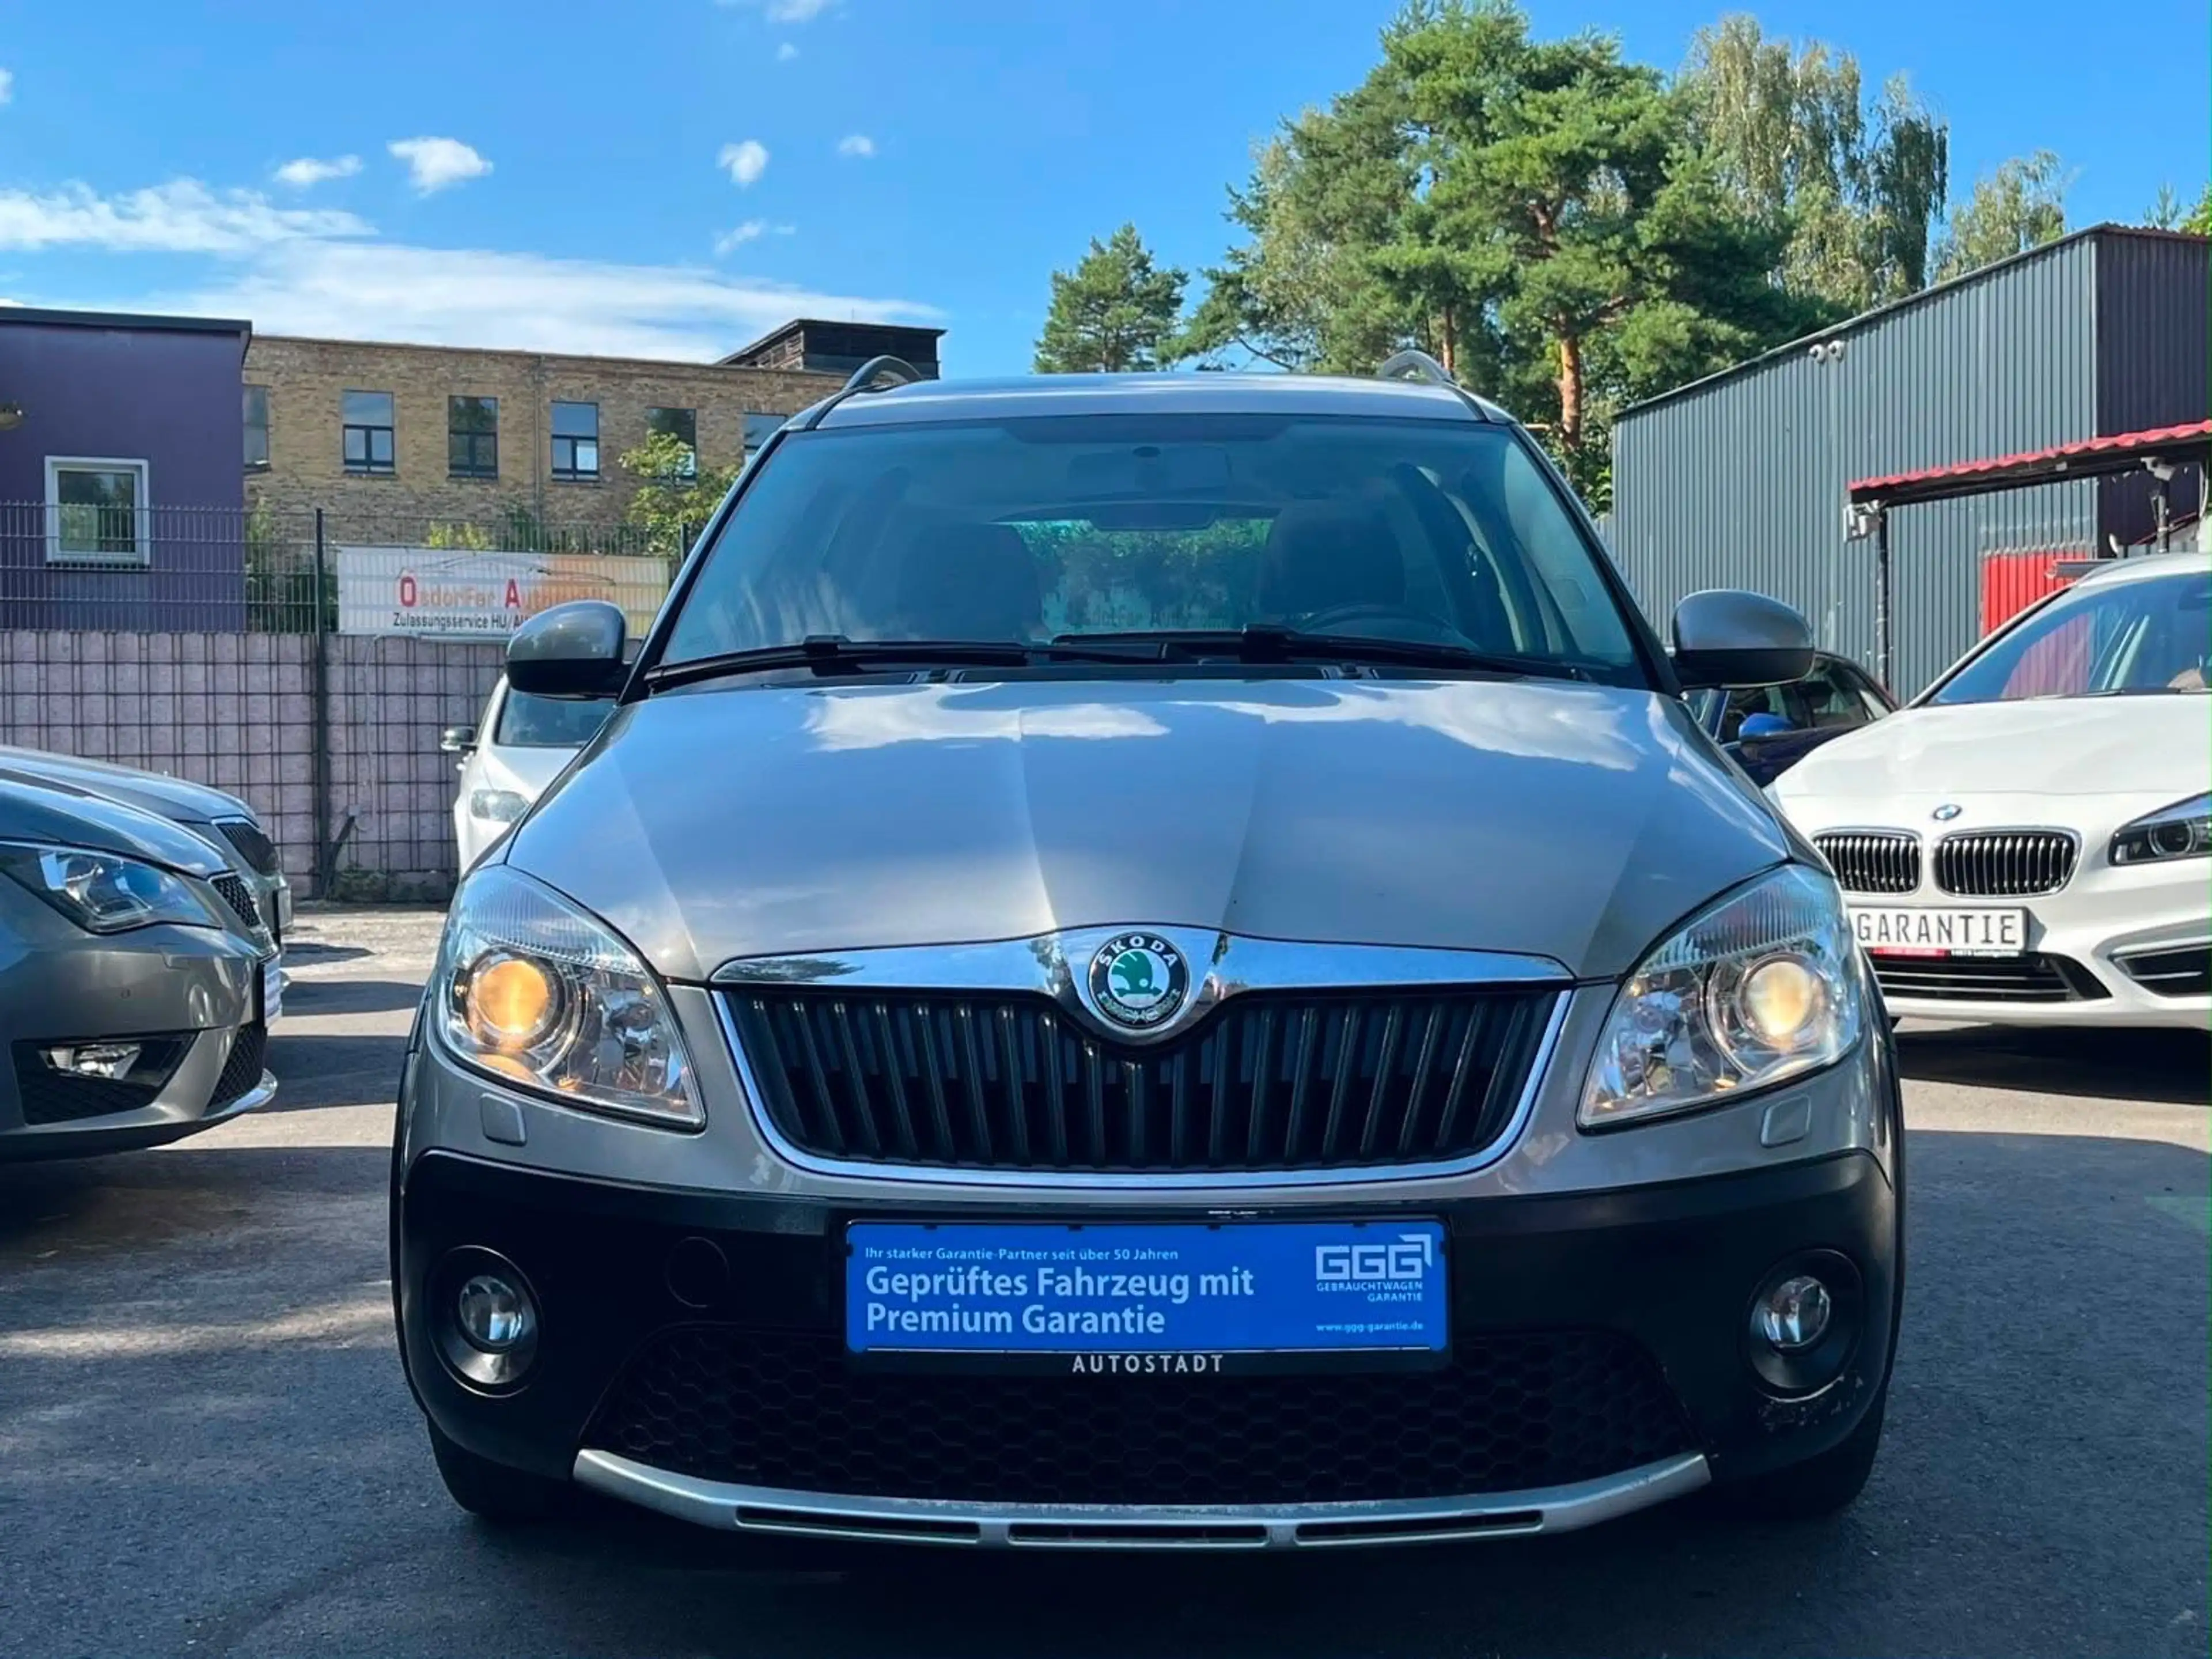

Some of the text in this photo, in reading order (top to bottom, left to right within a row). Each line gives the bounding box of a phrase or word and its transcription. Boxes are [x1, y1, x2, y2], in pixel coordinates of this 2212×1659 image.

[393, 612, 488, 630] Zulassungsservice
[1856, 912, 2017, 945] GARANTIE
[865, 1247, 884, 1259] Ihr
[887, 1247, 933, 1259] starker
[1051, 1248, 1076, 1261] seit
[1079, 1248, 1111, 1261] über
[1113, 1248, 1130, 1260] 50
[1133, 1247, 1179, 1261] Jahren
[1316, 1244, 1423, 1281] GGG
[866, 1266, 1255, 1304] Geprüftes Fahrzeug mit
[1316, 1281, 1423, 1292] GEBRAUCHTWAGEN
[1367, 1292, 1423, 1302] GARANTIE
[867, 1303, 1166, 1334] Premium Garantie
[1072, 1354, 1224, 1374] AUTOSTADT
